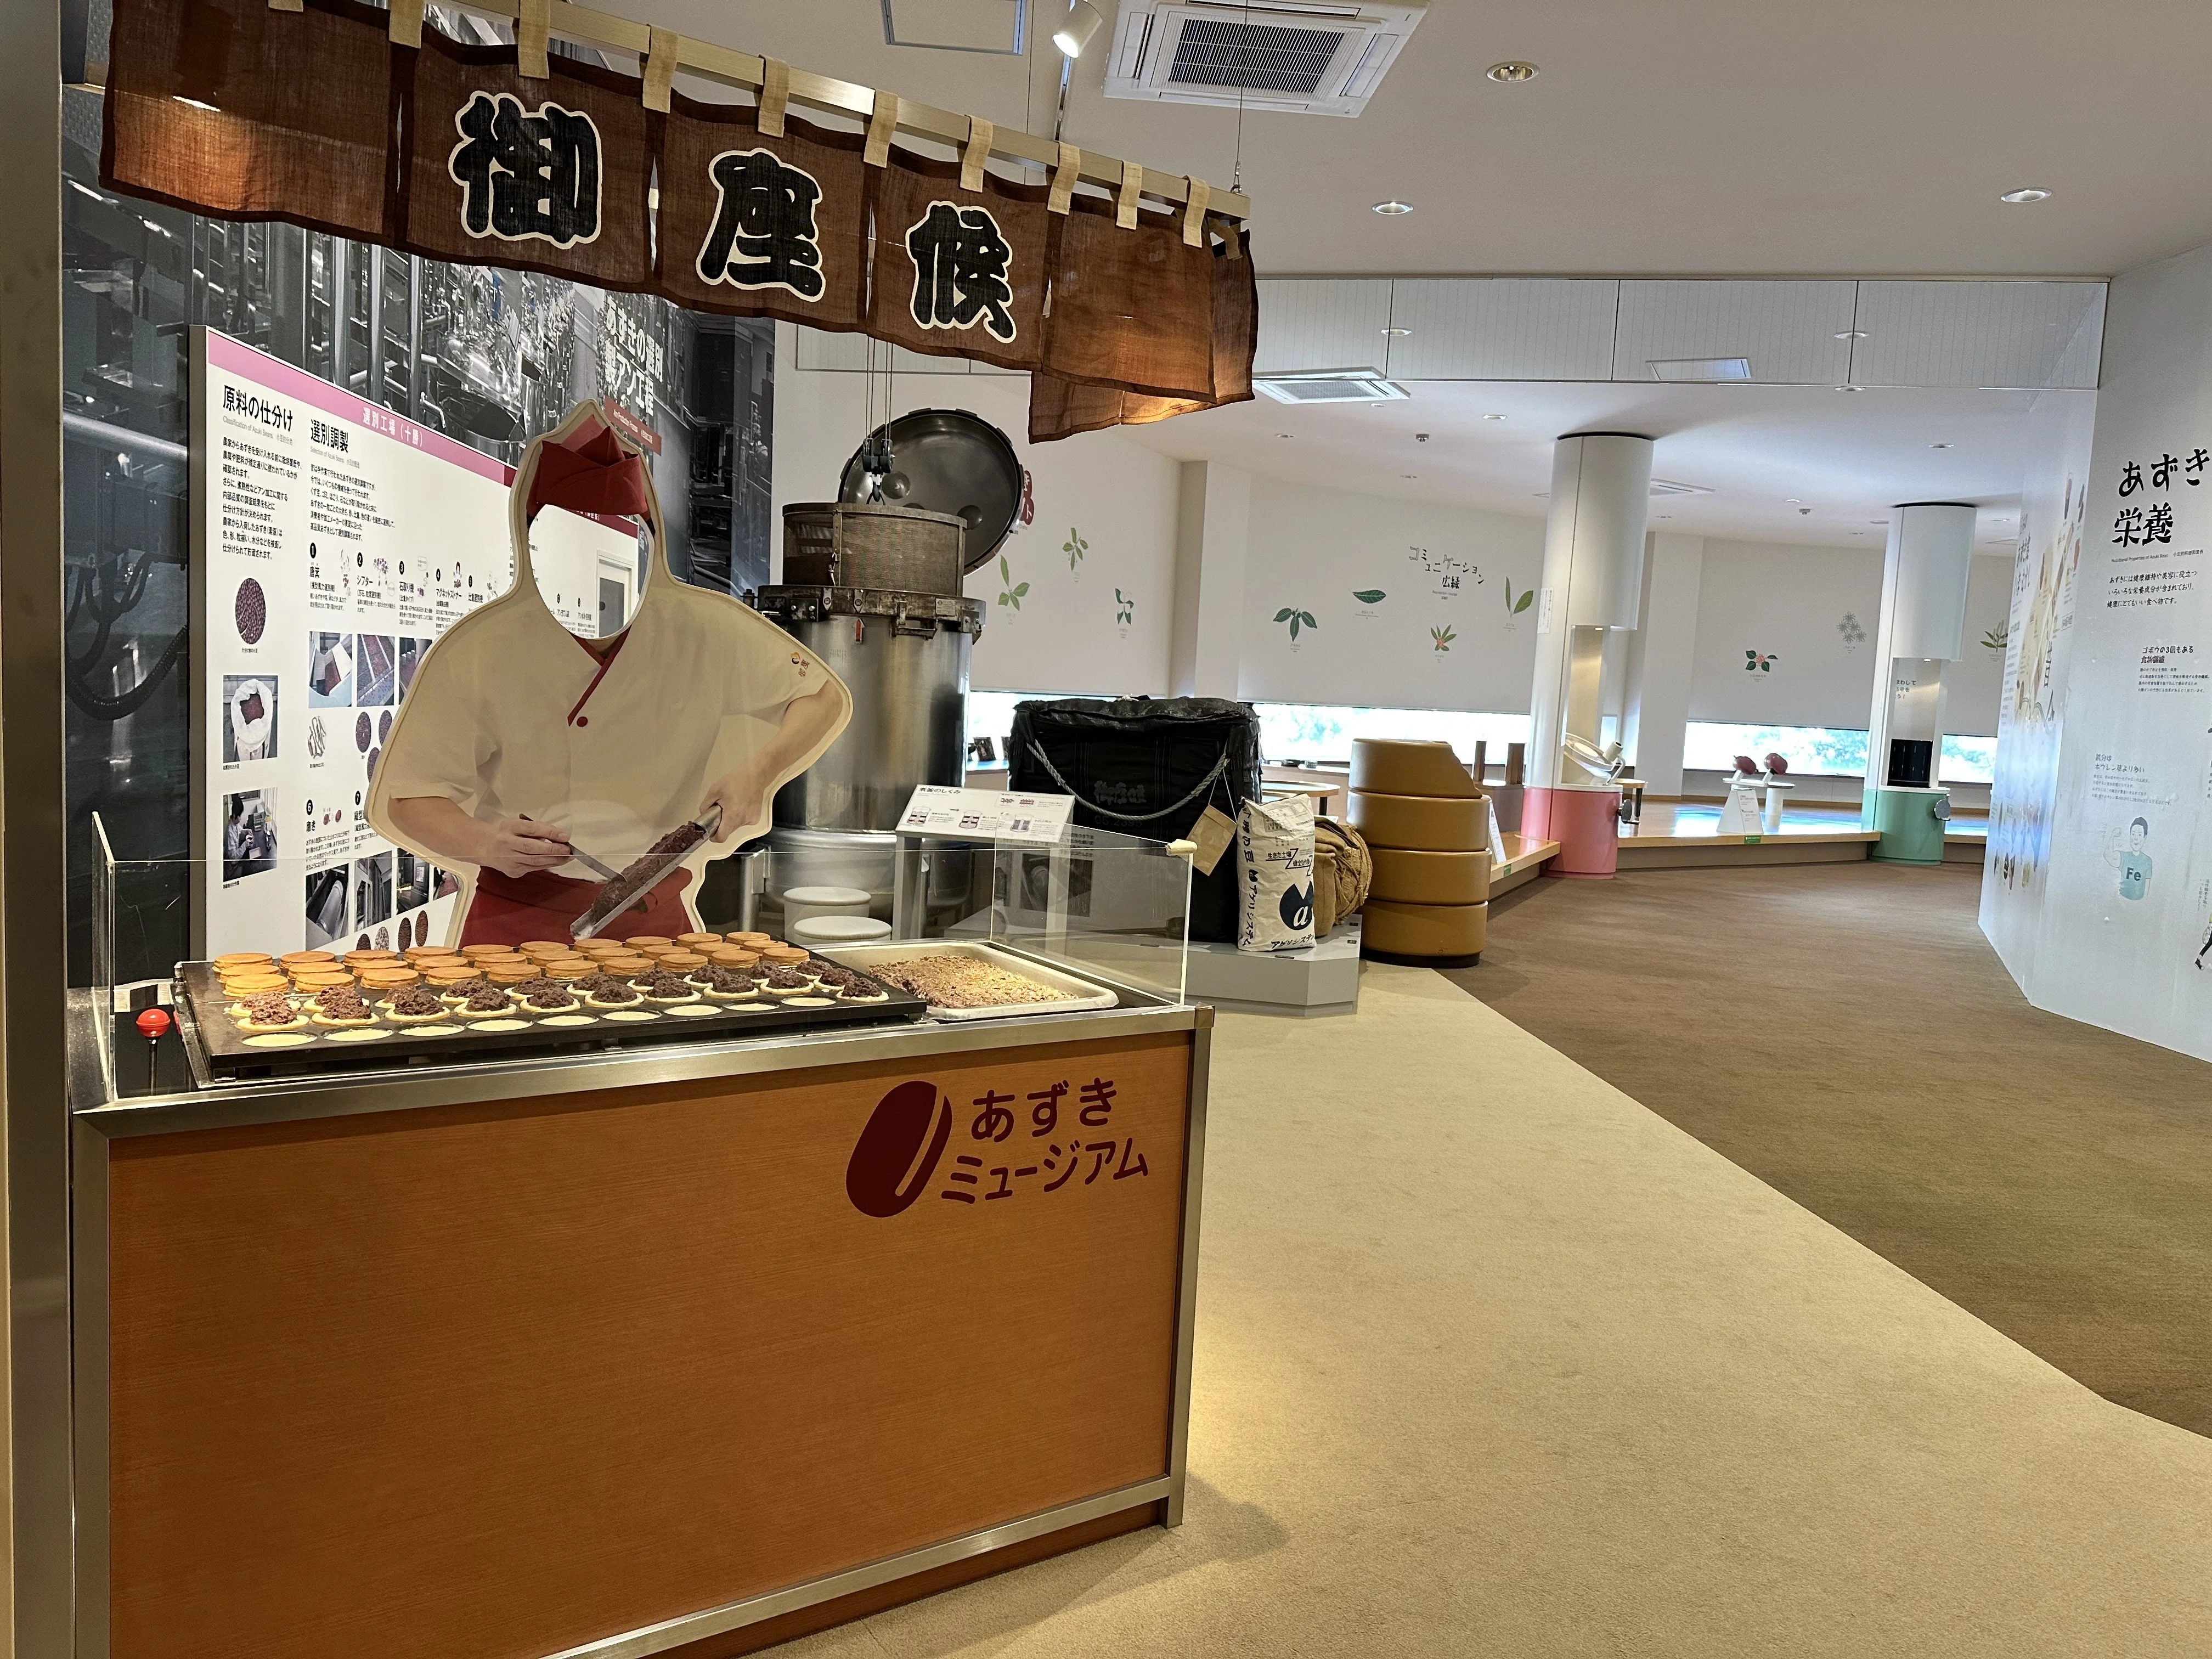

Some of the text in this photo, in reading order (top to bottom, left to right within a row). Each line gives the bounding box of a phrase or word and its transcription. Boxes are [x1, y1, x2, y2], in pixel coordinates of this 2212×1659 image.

[449, 91, 1017, 343] 御座候
[605, 294, 663, 383] あずきの選別
[604, 340, 654, 417] 製アン工程
[223, 385, 293, 432] 原料の仕分け
[363, 407, 423, 447] 選別工場（十勝）
[311, 419, 348, 453] 選別調製
[2118, 449, 2210, 498] あずき
[2112, 502, 2174, 548] 栄養
[357, 575, 373, 586] シフター
[1409, 546, 1484, 584] コミュニケーション
[2142, 645, 2194, 654] ゴボウの3倍もある
[2126, 867, 2141, 882] Fe
[1271, 933, 1315, 949] アグリシステ
[971, 1077, 1118, 1143] あずき
[940, 1137, 1149, 1205] ミュージアム
